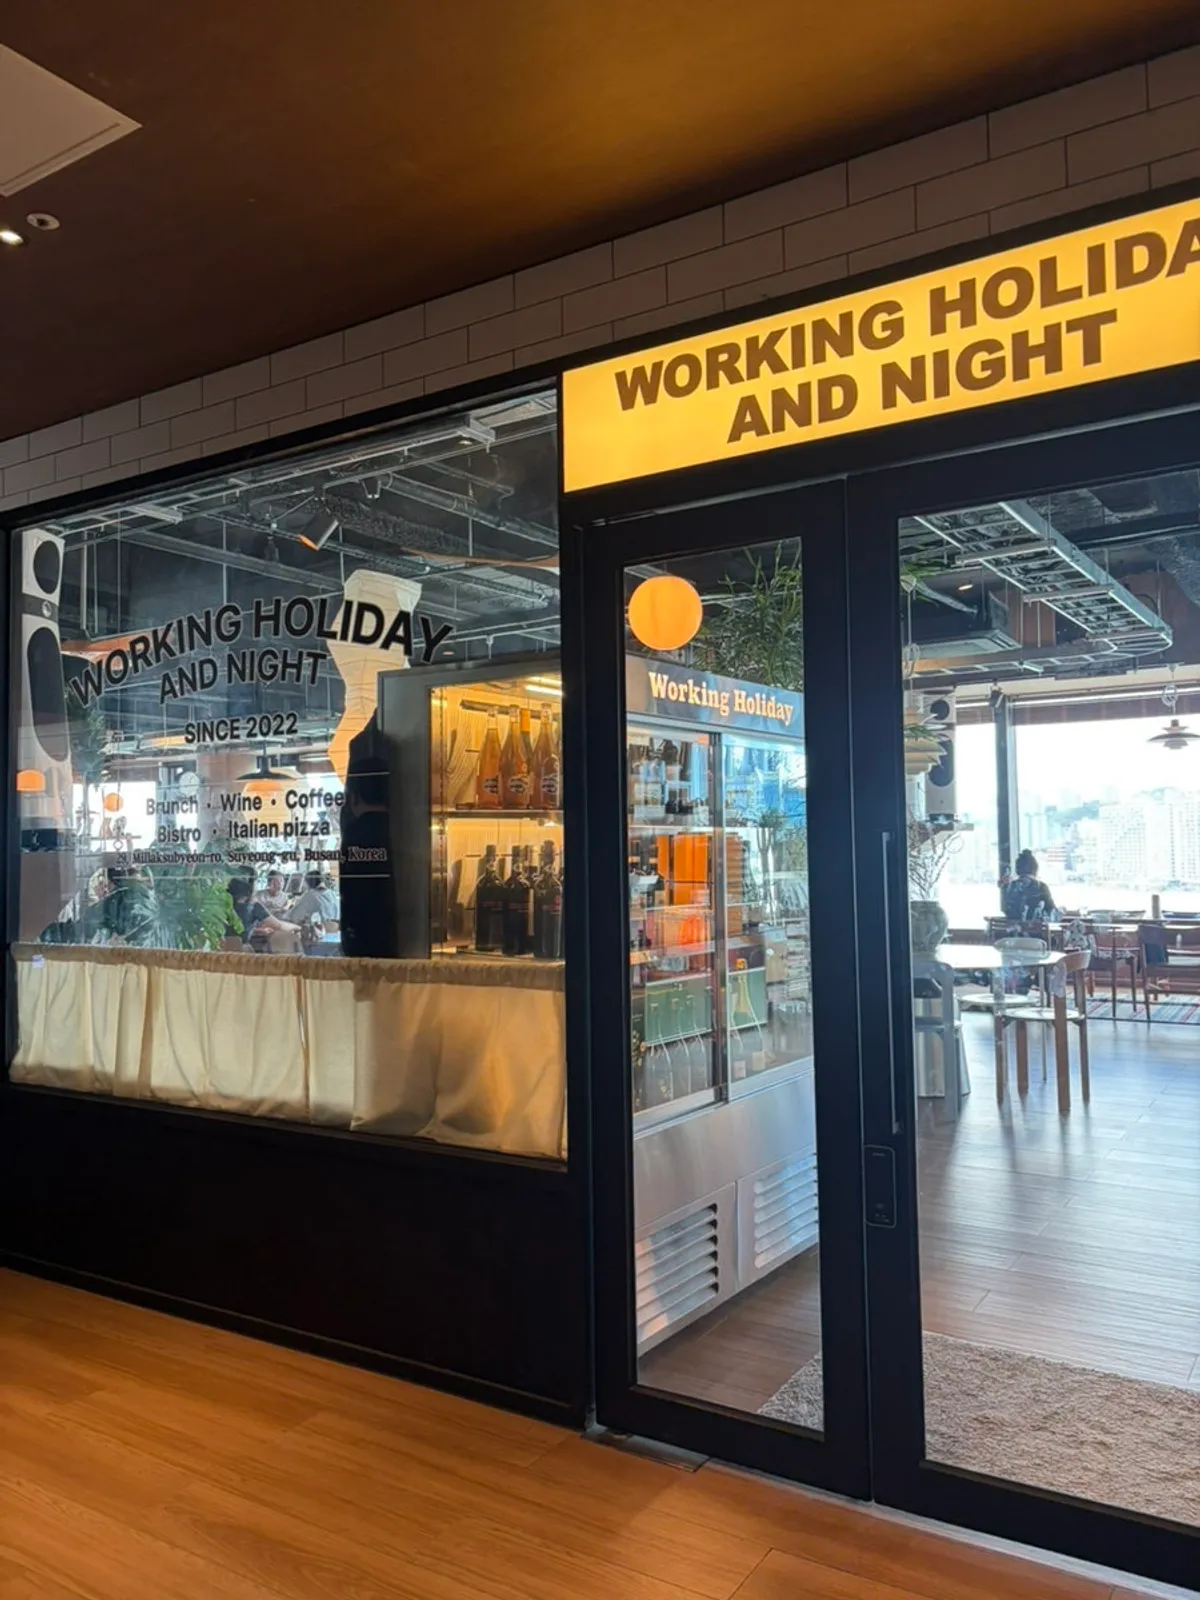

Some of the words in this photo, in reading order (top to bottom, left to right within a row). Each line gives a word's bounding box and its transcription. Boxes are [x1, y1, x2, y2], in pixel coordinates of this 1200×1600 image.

[614, 299, 905, 411] WORKING
[929, 217, 1200, 336] HOLIDA
[726, 374, 858, 444] AND
[881, 309, 1117, 410] NIGHT
[68, 603, 242, 708] WORKING
[252, 596, 454, 664] HOLIDAY
[159, 656, 219, 705] AND
[226, 648, 327, 687] NIGHT
[648, 671, 730, 717] Working
[733, 689, 795, 726] Holiday
[184, 718, 240, 745] SINCE
[245, 712, 299, 737] 2022
[145, 796, 199, 816] Brunch
[220, 793, 263, 811] Wine
[285, 789, 345, 809] Coffee
[157, 825, 201, 843] Bistro
[229, 819, 278, 839] Italian
[283, 818, 331, 840] pizza
[348, 847, 388, 861] Korea
